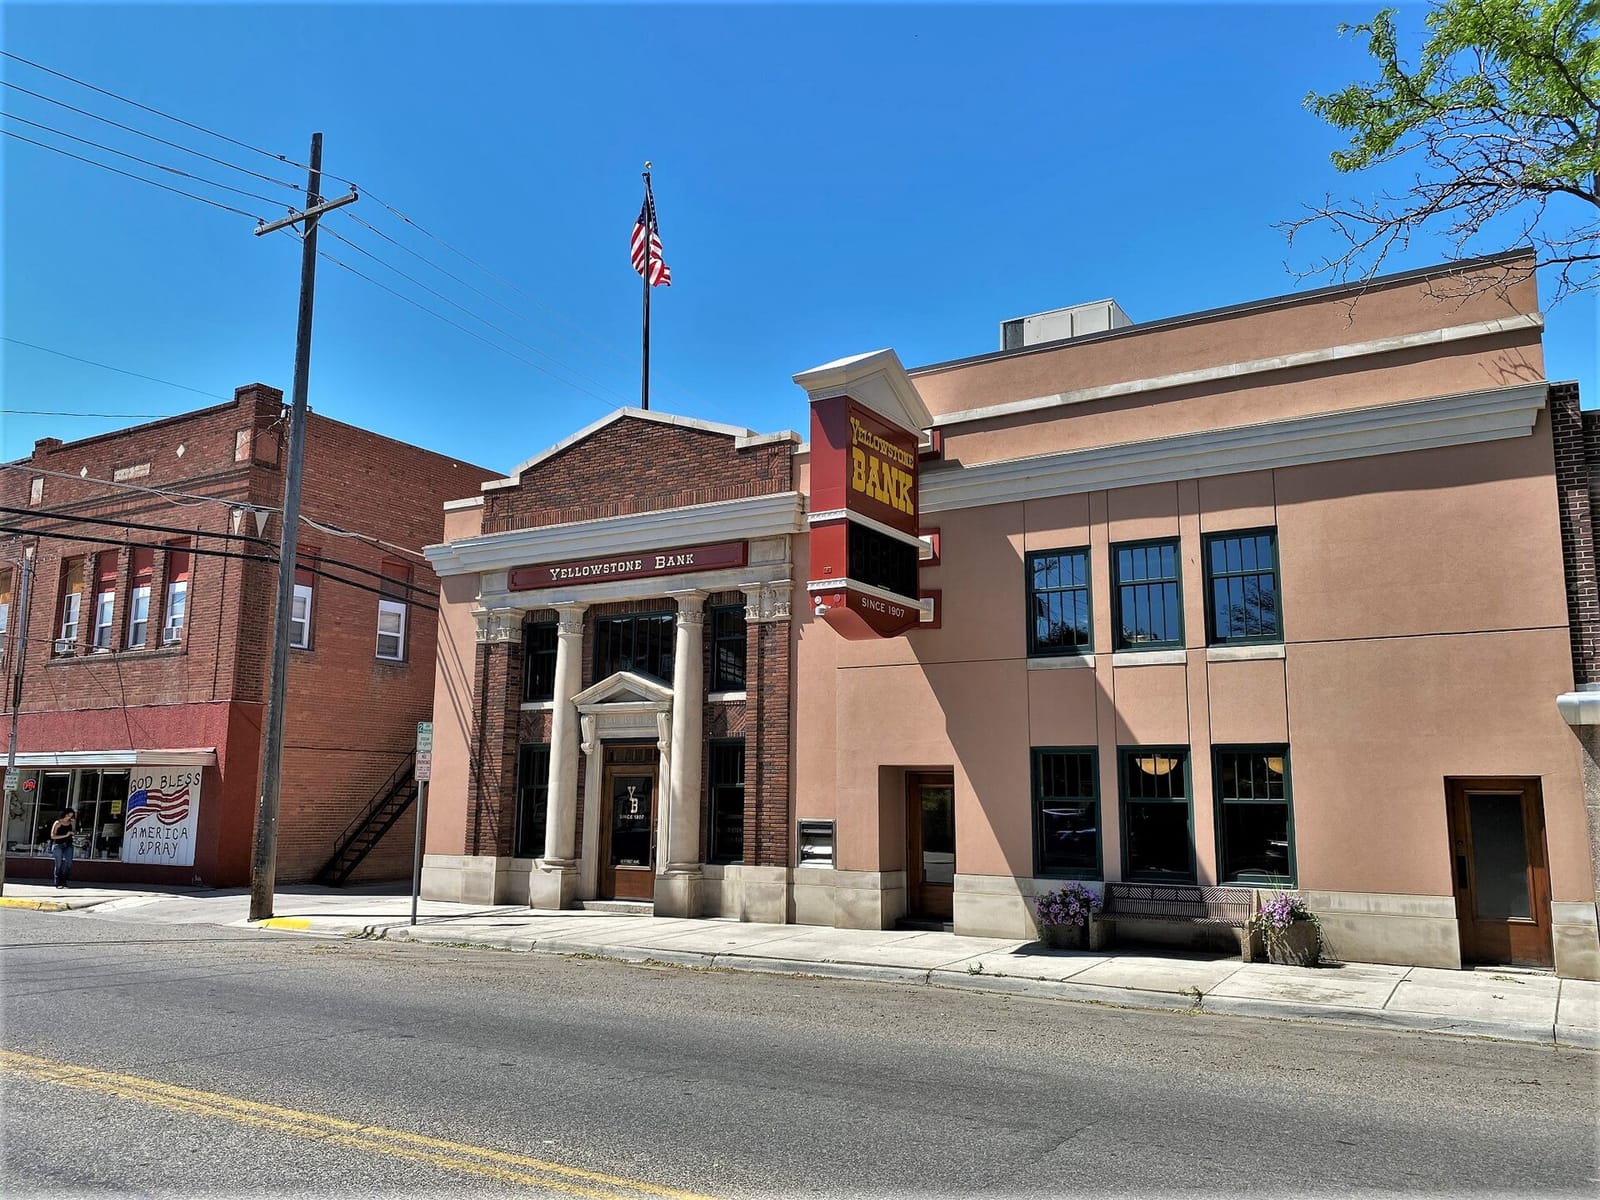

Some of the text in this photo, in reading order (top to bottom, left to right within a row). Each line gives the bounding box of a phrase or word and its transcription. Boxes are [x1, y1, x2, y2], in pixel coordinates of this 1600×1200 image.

[850, 416, 914, 469] YELLOWSTONE
[852, 446, 914, 516] BANK
[550, 554, 694, 581] YELLOWSTONE BANK
[861, 597, 905, 618] SINCE 1907
[419, 722, 424, 733] 2
[130, 773, 201, 794] GOD BLESS
[131, 826, 188, 840] AMERICA
